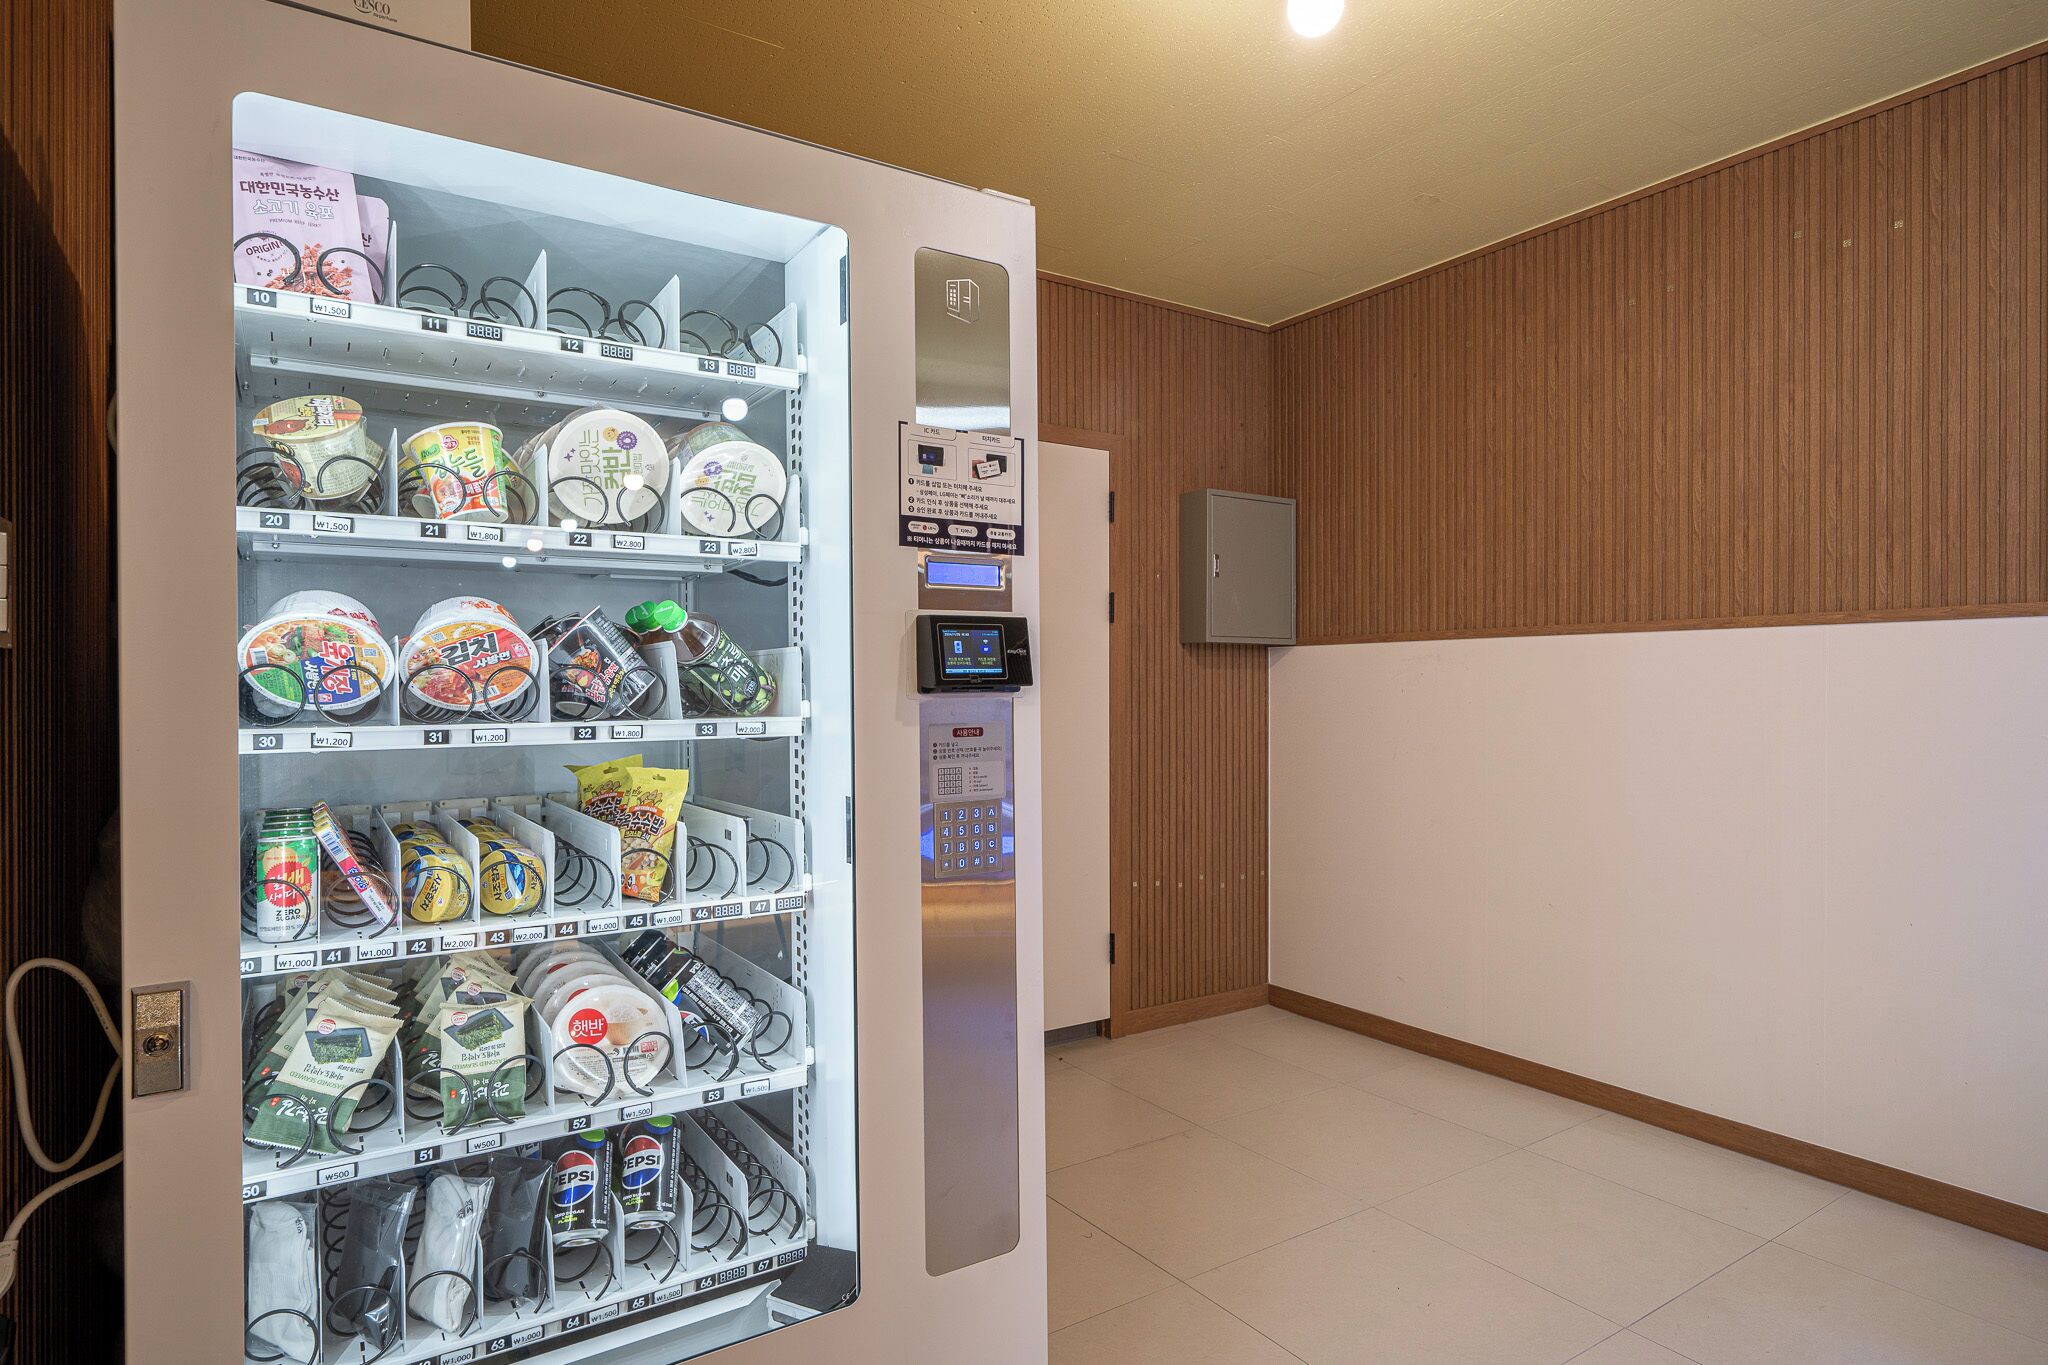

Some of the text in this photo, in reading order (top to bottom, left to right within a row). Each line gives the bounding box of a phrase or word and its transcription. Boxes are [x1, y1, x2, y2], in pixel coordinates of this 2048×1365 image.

[353, 0, 391, 15] CESCO
[239, 180, 340, 202] 대한민국농수산
[252, 198, 335, 220] 소고기 육포
[246, 240, 285, 256] ORIGIN
[253, 291, 270, 303] 10
[427, 318, 440, 329] 11
[566, 339, 579, 350] 12
[704, 360, 715, 371] 13
[982, 435, 1001, 444] 터치카드
[931, 481, 941, 489] 삽입
[942, 482, 953, 490] 또는
[953, 483, 968, 492] 터치해
[968, 485, 983, 493] 주세요
[926, 498, 937, 506] 인식
[943, 500, 959, 508] 상품을
[959, 501, 974, 509] 선택해
[974, 503, 989, 511] 주세요
[998, 497, 1016, 505] 대주세요
[265, 515, 283, 526] 20
[959, 511, 974, 519] 카드를
[974, 512, 998, 520] 꺼내주세요
[425, 525, 440, 536] 21
[573, 534, 587, 545] 22
[913, 536, 934, 544] 티머니는
[934, 537, 950, 545] 상품이
[976, 540, 991, 549] 카드를
[1001, 542, 1017, 550] 마세요
[704, 542, 717, 552] 23
[440, 632, 499, 666] 김치
[473, 650, 512, 669] 사발면
[319, 640, 354, 694] 육개장
[578, 728, 592, 739] 32
[701, 724, 713, 735] 33
[956, 728, 980, 737] 사용안내
[258, 736, 276, 748] 30
[428, 732, 443, 743] 31
[944, 808, 995, 820] 1 2 3 A
[943, 824, 995, 837] 4 5 6 B
[943, 840, 995, 853] 7 8 9 C
[959, 858, 965, 868] 0
[989, 856, 995, 864] D
[490, 864, 503, 902] 사조참치
[268, 889, 298, 902] 사이다
[420, 873, 443, 912] 사조참치
[275, 908, 301, 917] ZERO
[695, 908, 709, 918] 46
[754, 902, 767, 912] 47
[275, 914, 301, 922] SUGAR
[630, 916, 644, 926] 45
[559, 924, 574, 935] 44
[489, 932, 504, 943] 43
[411, 941, 427, 952] 42
[326, 950, 342, 962] 41
[240, 961, 255, 973] 40
[572, 1018, 604, 1038] 햇반
[461, 1051, 501, 1062] 파래도시락김
[451, 1061, 479, 1070] SEAWEED
[303, 1063, 345, 1081] 파래도시락김
[708, 1090, 721, 1101] 53
[572, 1118, 586, 1130] 52
[419, 1149, 434, 1161] 51
[623, 1154, 661, 1169] PEPSI
[553, 1169, 595, 1186] PEPSI
[243, 1185, 260, 1197] 50
[757, 1259, 770, 1271] 67
[700, 1277, 713, 1288] 66
[632, 1297, 646, 1309] 65
[566, 1316, 581, 1328] 64
[491, 1339, 505, 1351] 63
